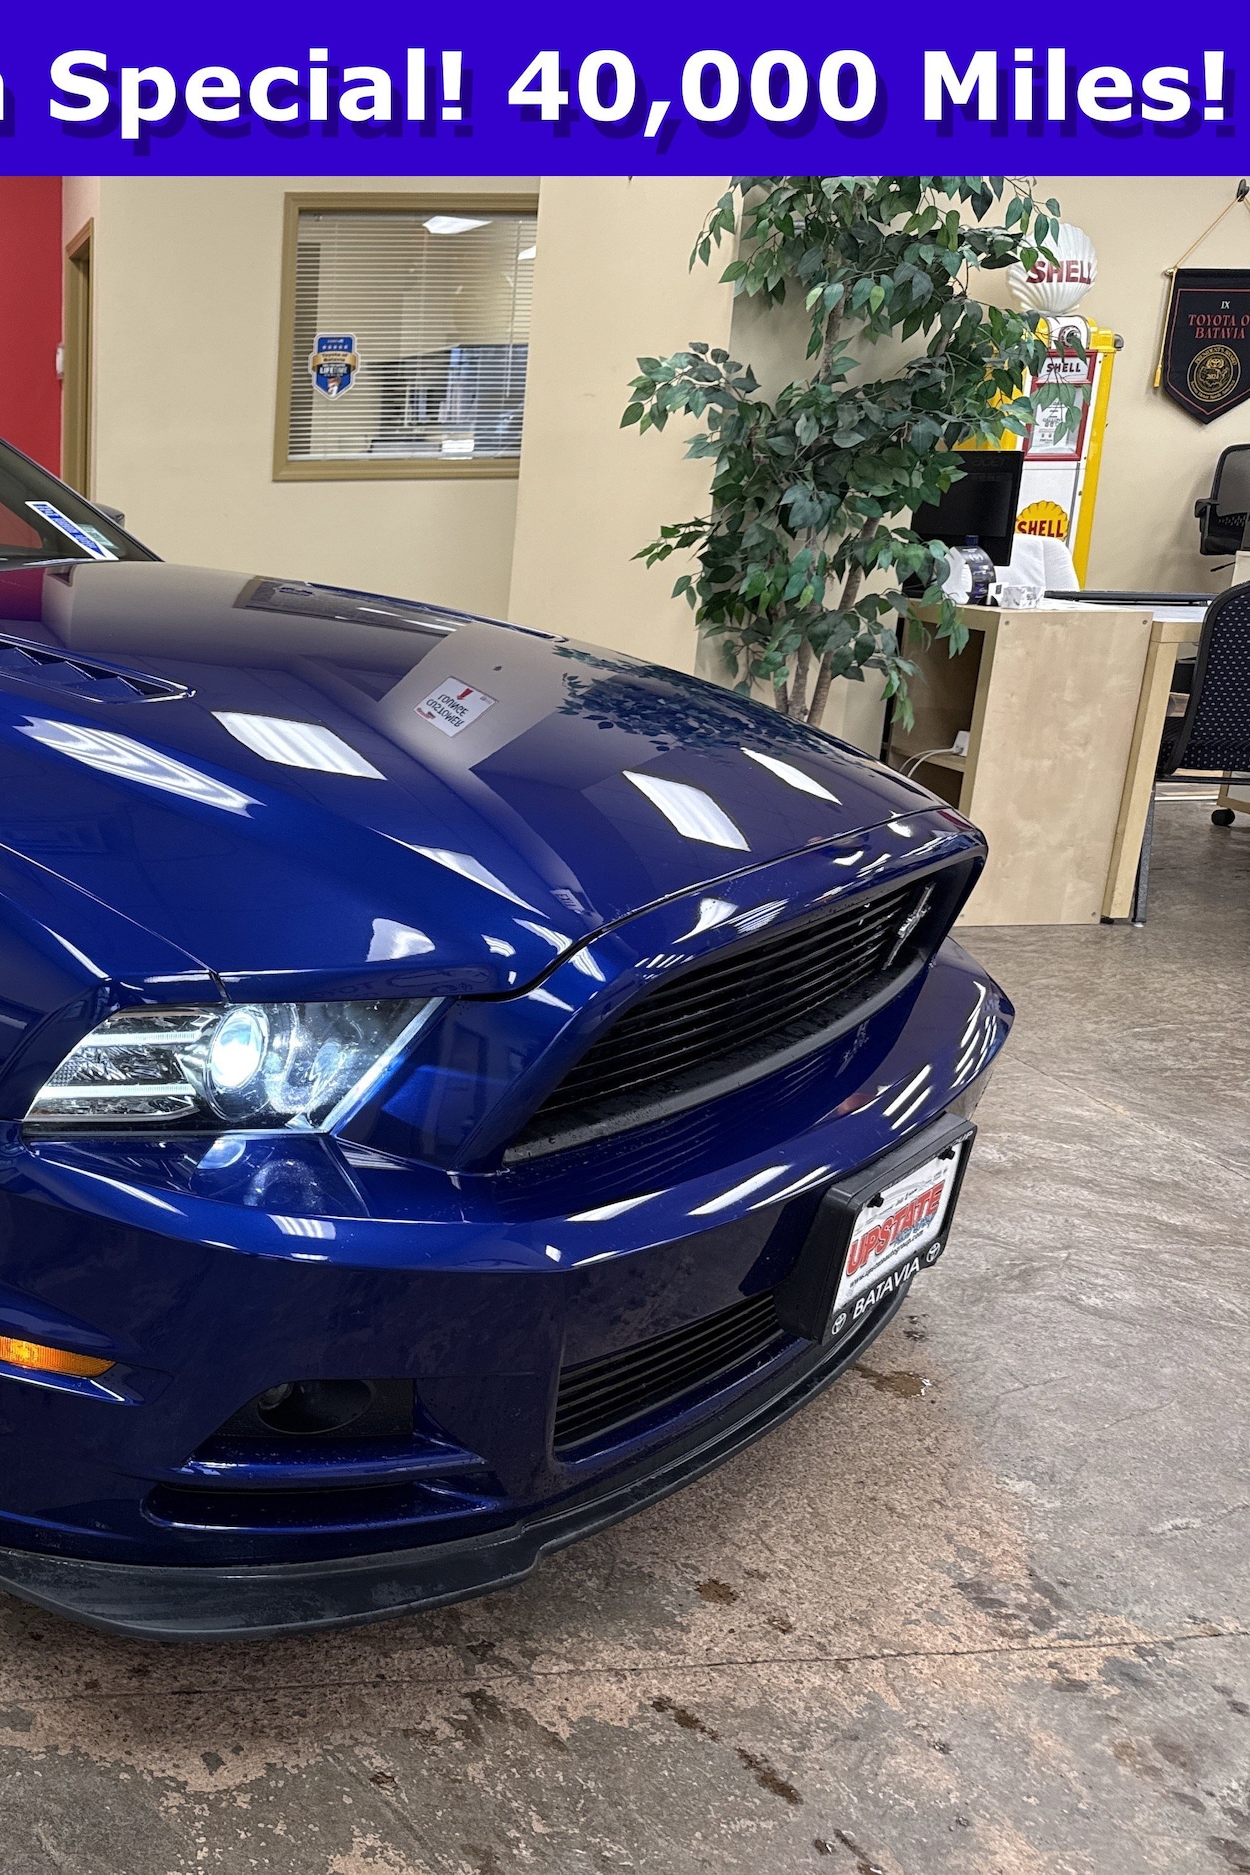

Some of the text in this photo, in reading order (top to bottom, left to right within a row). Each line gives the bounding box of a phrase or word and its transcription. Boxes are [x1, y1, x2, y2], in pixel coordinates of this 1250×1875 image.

[1026, 260, 1092, 284] SHELL
[1221, 301, 1230, 310] IX
[1188, 314, 1236, 327] TOYOTA
[1195, 328, 1246, 339] BATAVIA
[1046, 362, 1081, 373] SHELL
[1017, 519, 1064, 538] SHELL
[846, 1180, 945, 1276] UPSTATE
[852, 1257, 920, 1320] BATAVIA
